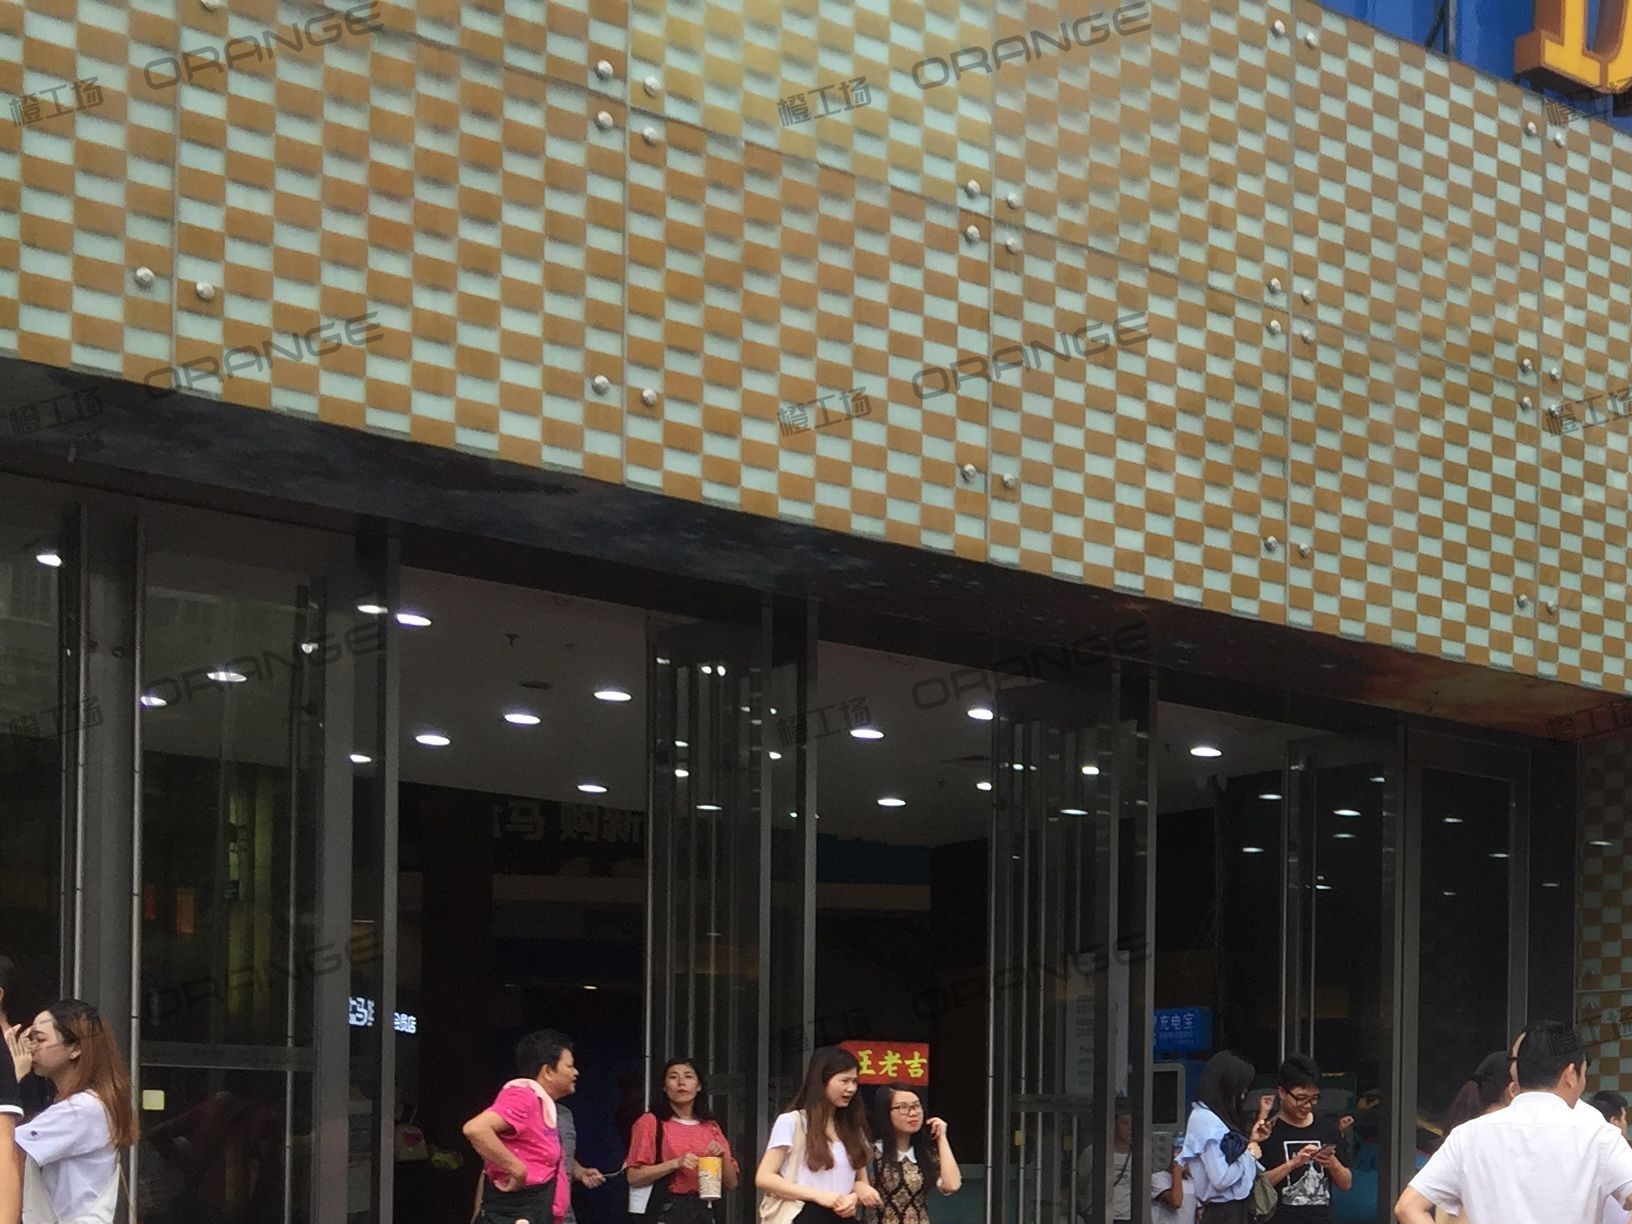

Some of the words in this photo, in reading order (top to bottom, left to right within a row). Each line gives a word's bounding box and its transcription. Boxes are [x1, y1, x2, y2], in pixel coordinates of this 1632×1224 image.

[1153, 1011, 1195, 1031] 充电宝
[857, 1048, 928, 1078] 王老吉
